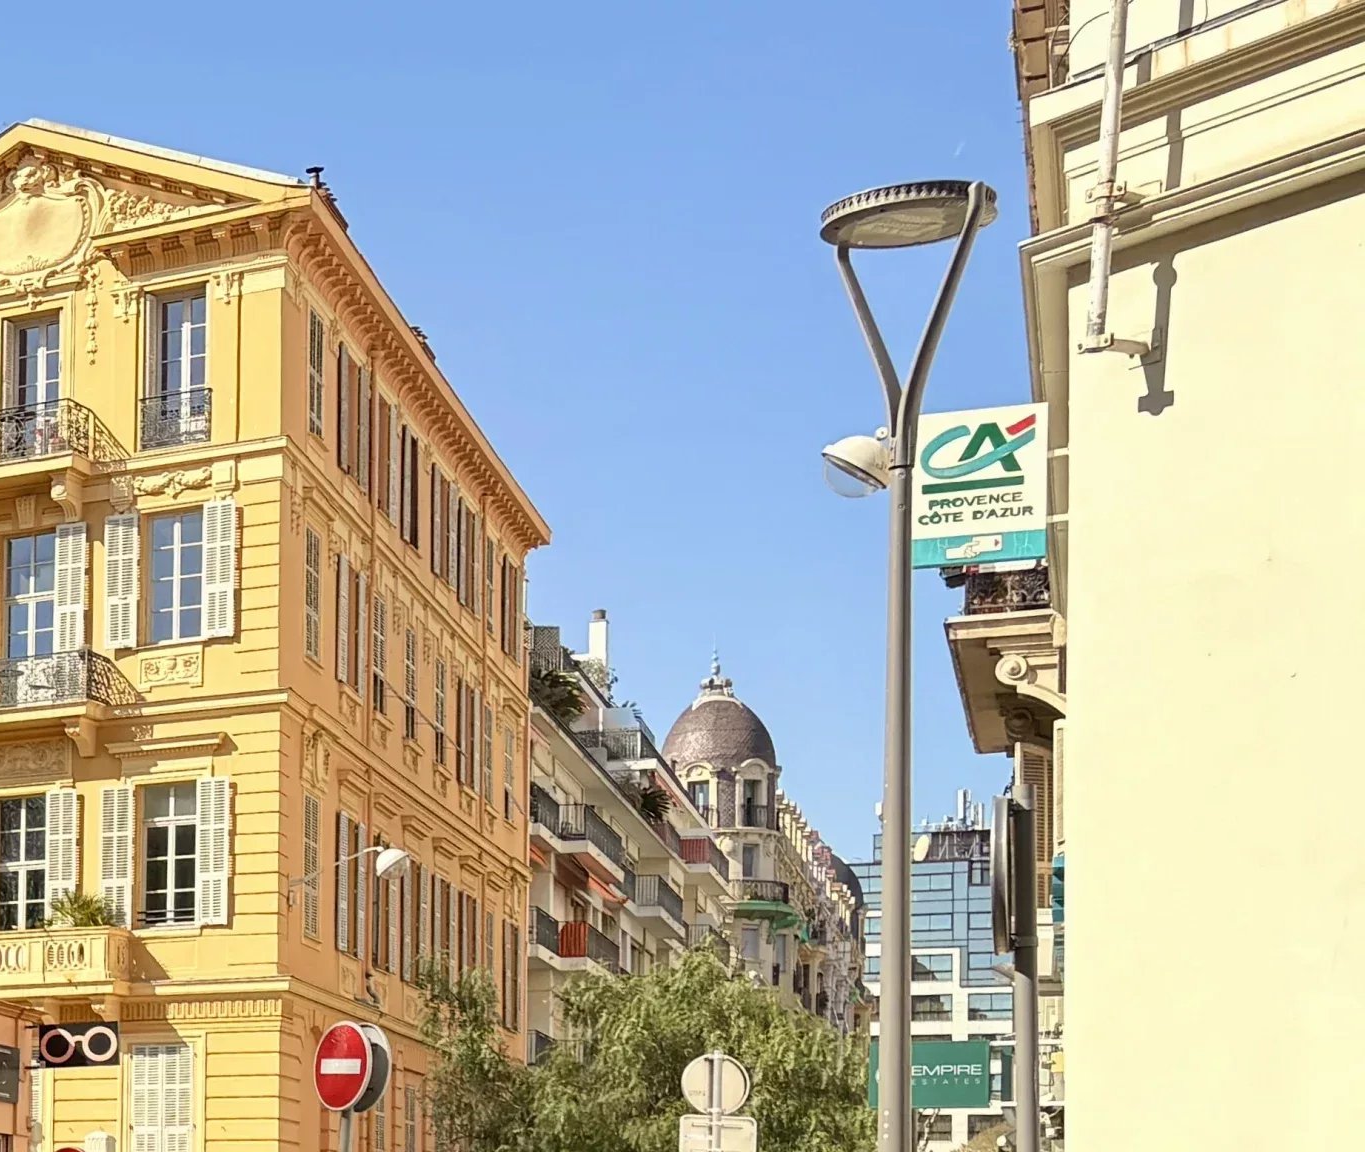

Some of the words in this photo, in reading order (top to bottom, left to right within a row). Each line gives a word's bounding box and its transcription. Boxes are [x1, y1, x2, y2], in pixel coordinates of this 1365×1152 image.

[928, 491, 1023, 511] PROVENCE
[918, 511, 964, 526] CÔTE
[972, 505, 1034, 521] D'AZUR
[911, 1064, 983, 1077] EMPIRE
[912, 1078, 981, 1086] ESTATES
